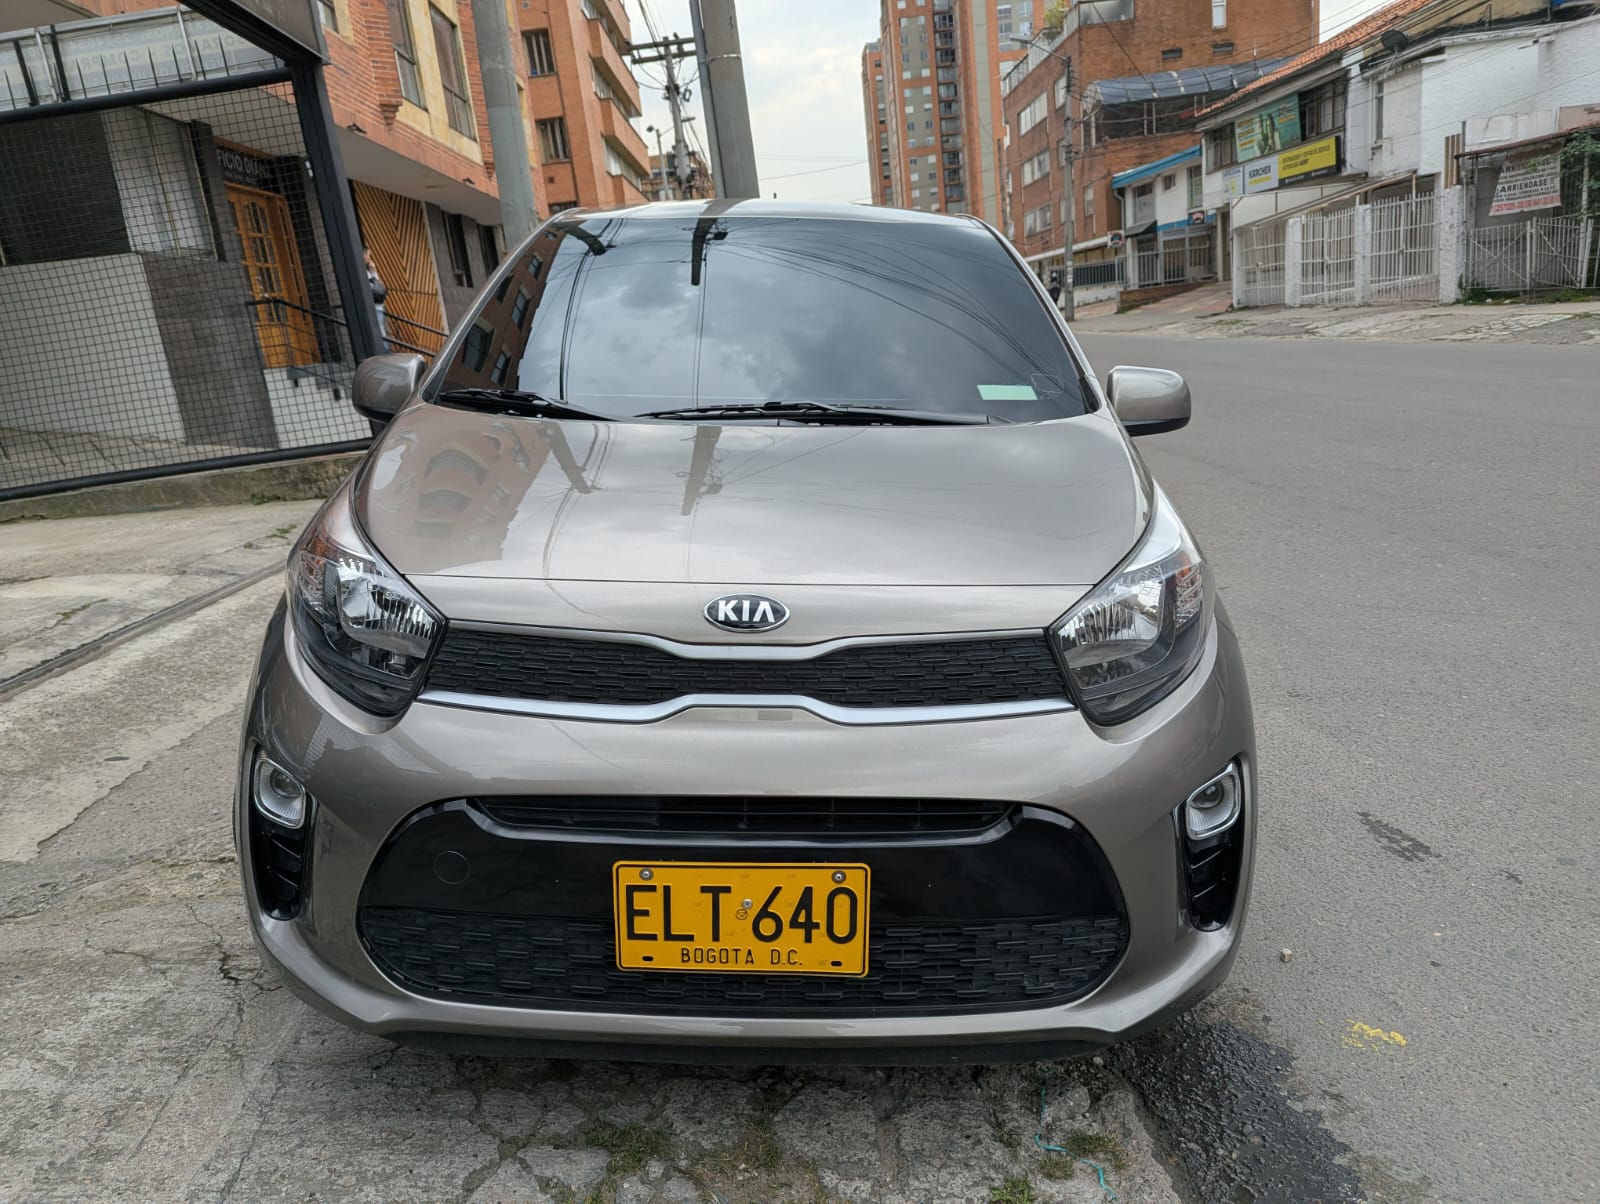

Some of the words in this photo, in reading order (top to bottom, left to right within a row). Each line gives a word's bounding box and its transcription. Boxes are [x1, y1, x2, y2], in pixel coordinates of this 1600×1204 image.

[718, 600, 775, 622] KIA
[625, 884, 732, 942] ELT
[752, 886, 858, 945] 640
[681, 948, 755, 965] BOGOTA
[770, 949, 803, 966] D.C.
